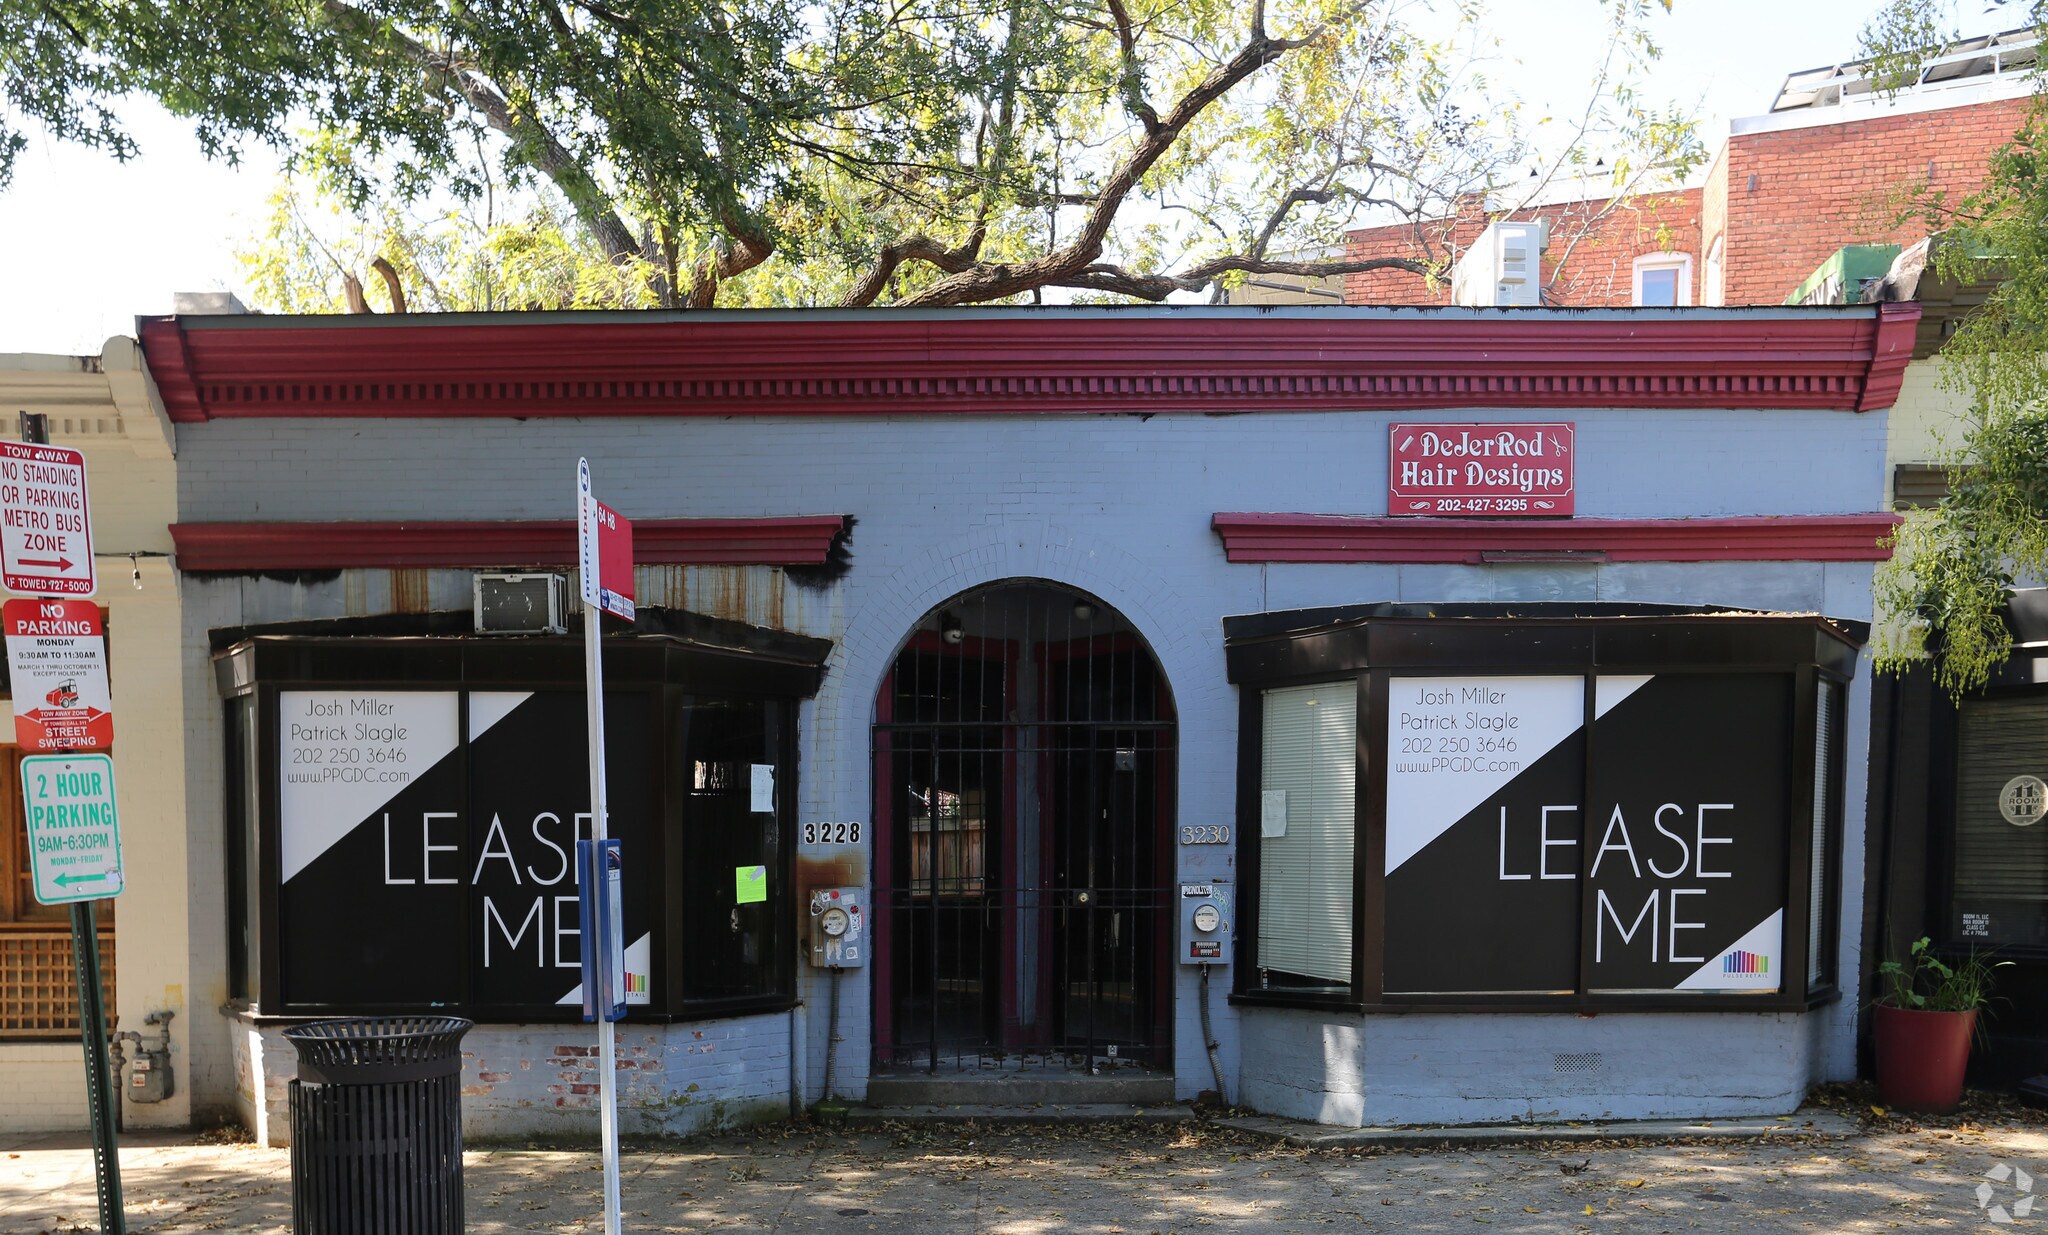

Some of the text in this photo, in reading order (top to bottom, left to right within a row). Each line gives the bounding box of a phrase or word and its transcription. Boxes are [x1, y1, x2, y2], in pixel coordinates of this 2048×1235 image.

[1420, 431, 1544, 457] DeJerRod
[5, 445, 70, 463] TOW AWAY
[1, 461, 77, 487] NO STANDING
[1400, 461, 1563, 492] Hair Designs
[2, 485, 79, 510] OR PARKING
[1436, 499, 1528, 512] 202-427-3295
[4, 508, 82, 533] METRO BUS
[23, 533, 67, 552] ZONE
[7, 577, 90, 592] IF TOWED 727-5000
[40, 604, 65, 619] NO
[16, 620, 92, 635] PARKING
[37, 639, 75, 647] MONDAY
[1415, 687, 1506, 705] Josh Miller
[305, 699, 394, 717] Josh Miller
[1401, 711, 1519, 732] Patrick Slagle
[45, 726, 87, 737] STREET
[291, 723, 408, 744] Patrick Slagle
[38, 736, 97, 748] SWEEPING
[1401, 736, 1517, 753] 202 250 3646
[293, 747, 407, 764] 202 250 3646
[1395, 756, 1520, 773] www.PPGDC.com
[37, 772, 103, 798] 2 HOUR
[287, 767, 410, 784] www.PPGDC.com
[2008, 797, 2039, 805] ROOM
[33, 802, 112, 830] PARKING
[805, 822, 860, 844] 3228
[1182, 825, 1230, 845] 3230
[1499, 802, 1734, 880] LEASE
[38, 833, 109, 853] 9AM-6:30PM
[484, 896, 582, 968] ME
[1596, 888, 1707, 963] ME
